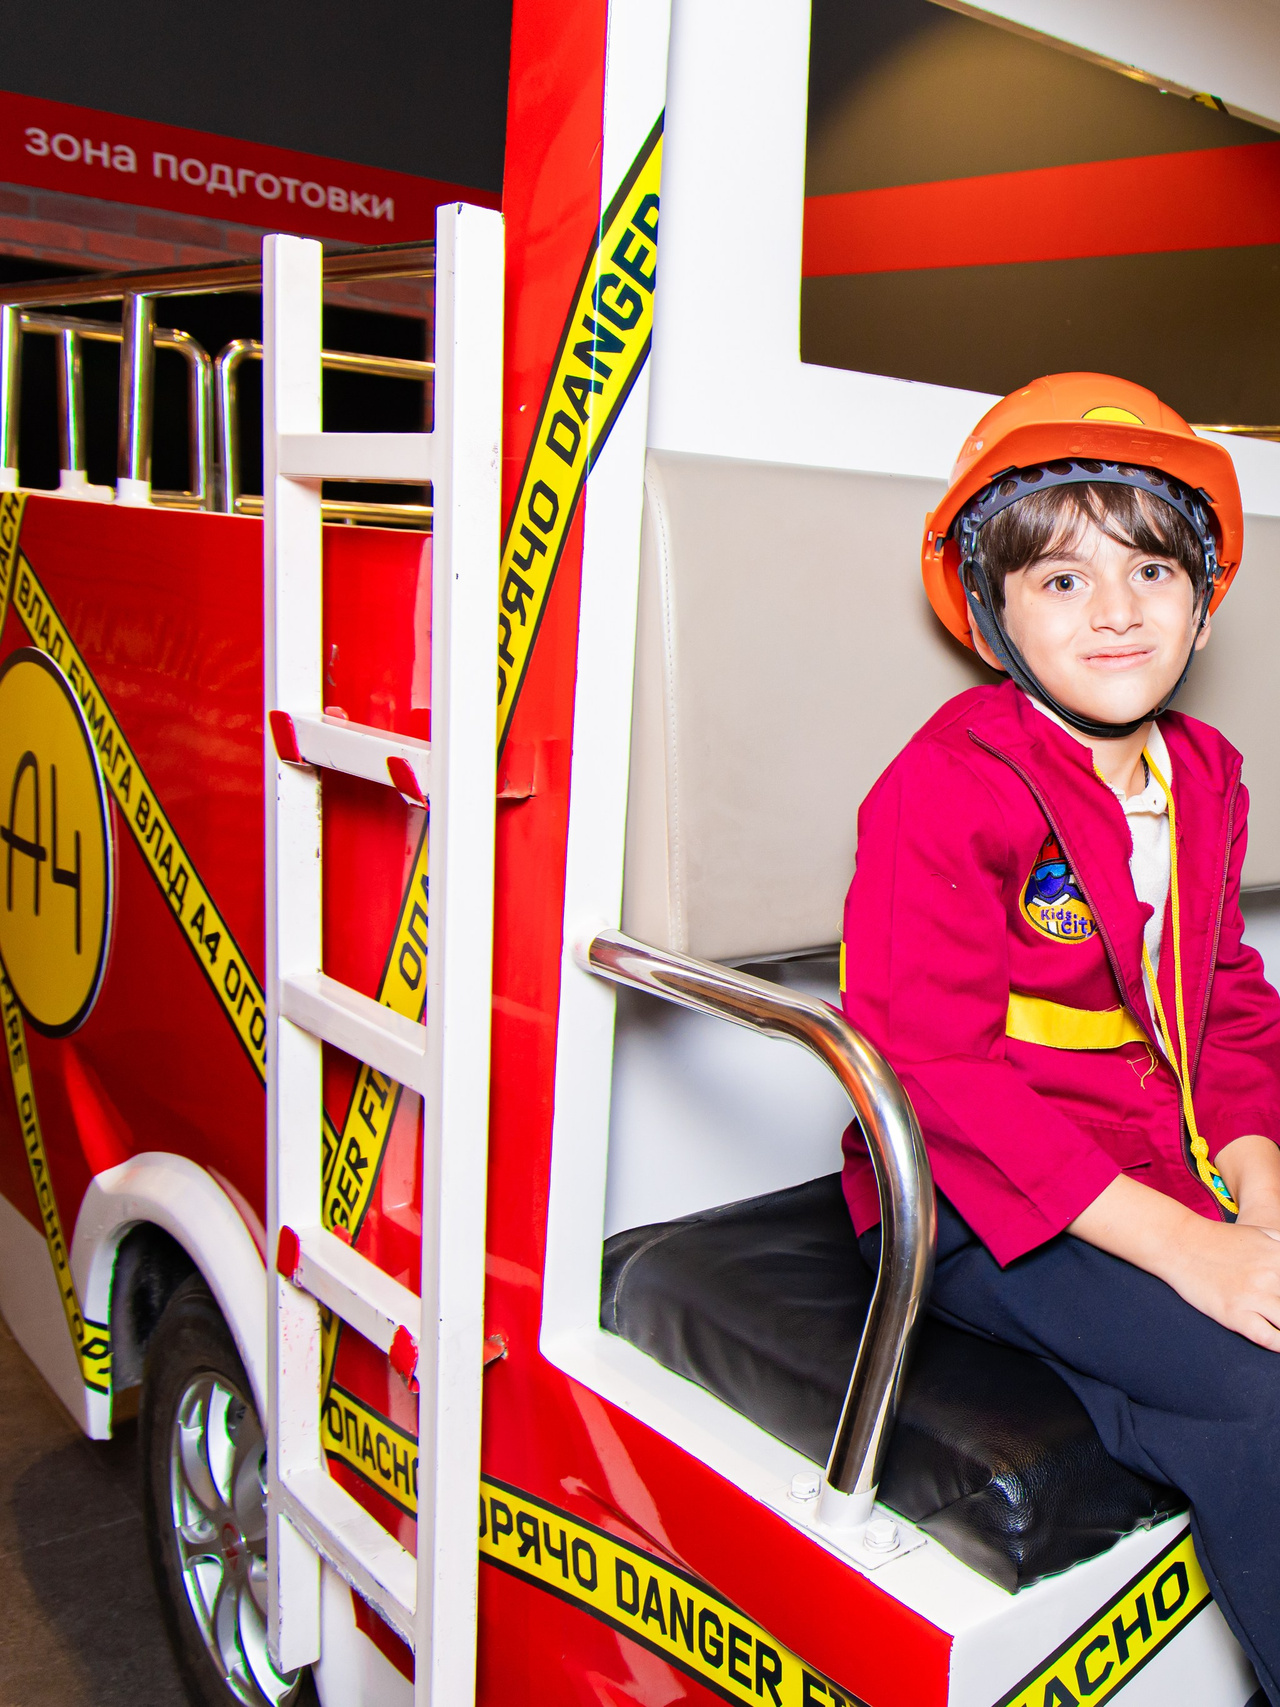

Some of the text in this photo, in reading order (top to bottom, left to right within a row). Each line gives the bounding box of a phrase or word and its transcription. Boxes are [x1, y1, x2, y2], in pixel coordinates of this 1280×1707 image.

[25, 127, 394, 222] зона подготовки
[18, 570, 65, 663] ВЛАД
[67, 660, 132, 803] БУМАГА
[135, 790, 190, 918] ВЛАД
[399, 873, 429, 991] ОП
[1040, 908, 1072, 921] Kids
[327, 1397, 419, 1499] ОПАСН
[615, 1557, 782, 1707] DANGER
